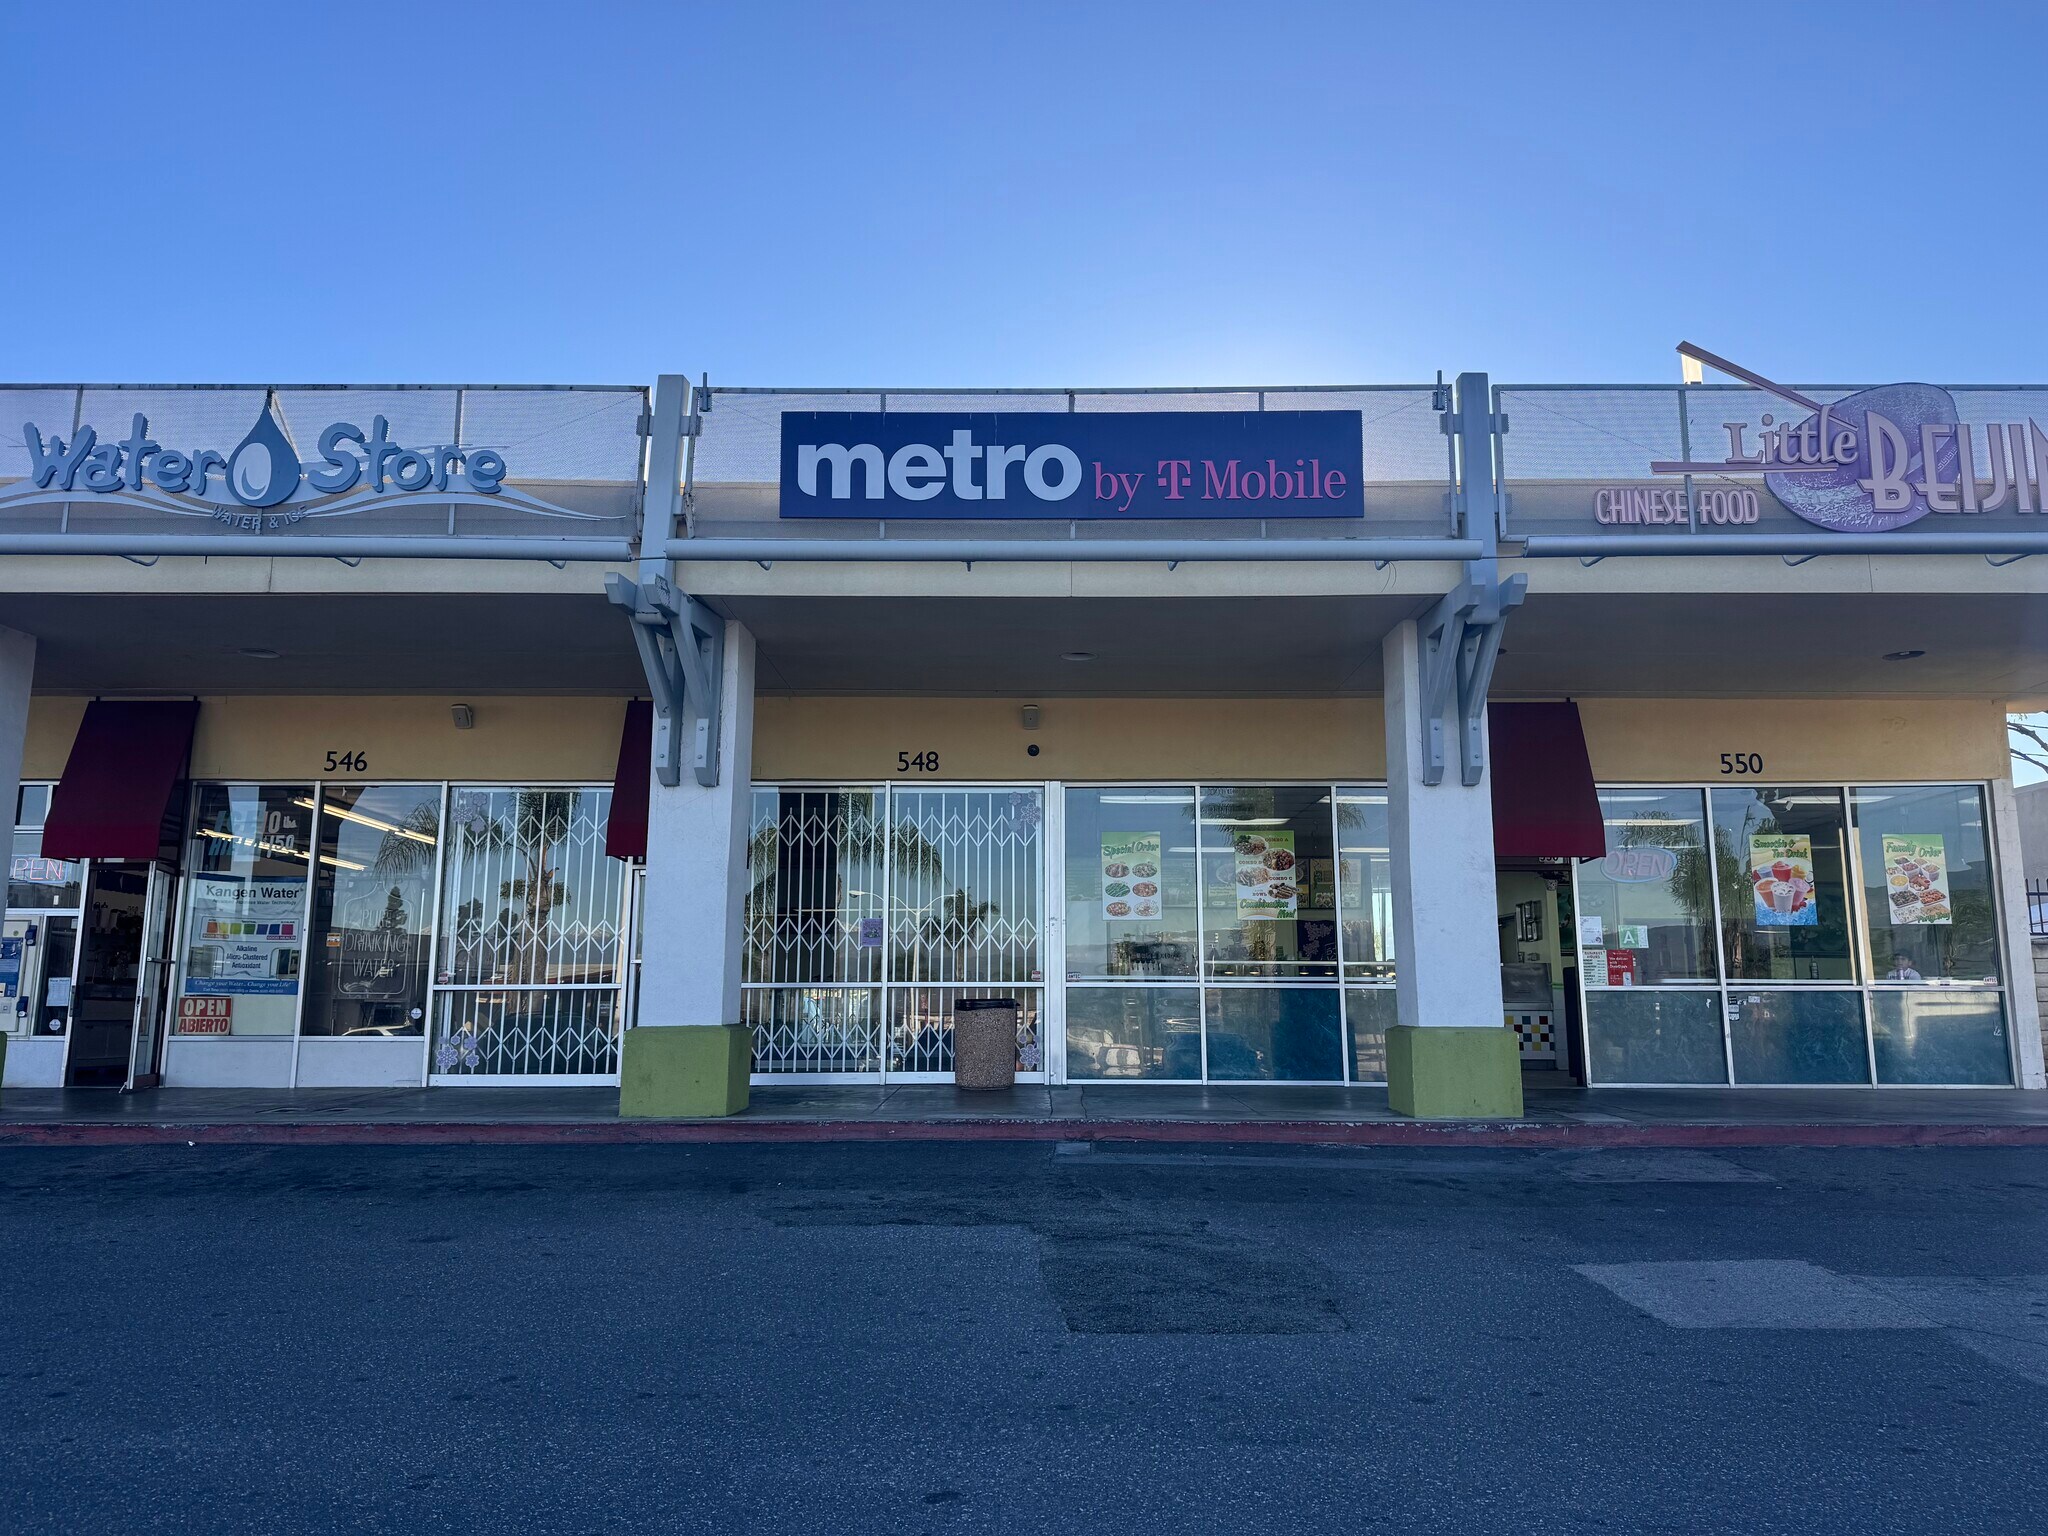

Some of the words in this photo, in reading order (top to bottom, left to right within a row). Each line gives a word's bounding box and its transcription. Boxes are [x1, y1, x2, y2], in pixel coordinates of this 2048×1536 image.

[1723, 404, 1858, 465] Little
[23, 412, 226, 495] Water
[309, 413, 508, 495] Store
[798, 430, 1082, 501] metro
[1092, 461, 1144, 512] by
[1201, 459, 1346, 500] Mobile
[1595, 487, 1689, 525] CHINESE
[1697, 488, 1760, 525] FOOD
[211, 504, 261, 530] WATER
[269, 516, 279, 529] &
[283, 505, 308, 525] ICE
[324, 751, 367, 771] 546
[897, 751, 939, 772] 548
[1720, 753, 1763, 774] 550
[1103, 841, 1135, 859] Special
[1136, 840, 1159, 852] Order
[1753, 838, 1788, 848] Smoothie
[1886, 841, 1917, 856] Family
[1919, 846, 1942, 857] Order
[13, 858, 63, 880] PEN
[1604, 850, 1671, 878] OPEN
[206, 885, 256, 900] Kangen
[261, 886, 299, 899] Water
[1241, 898, 1289, 908] Combination
[362, 910, 391, 927] PURE
[344, 932, 408, 952] DRINKING
[1623, 930, 1635, 944] A
[353, 958, 394, 978] WATER
[184, 999, 227, 1016] OPEN
[178, 1018, 228, 1033] ABIERTO
